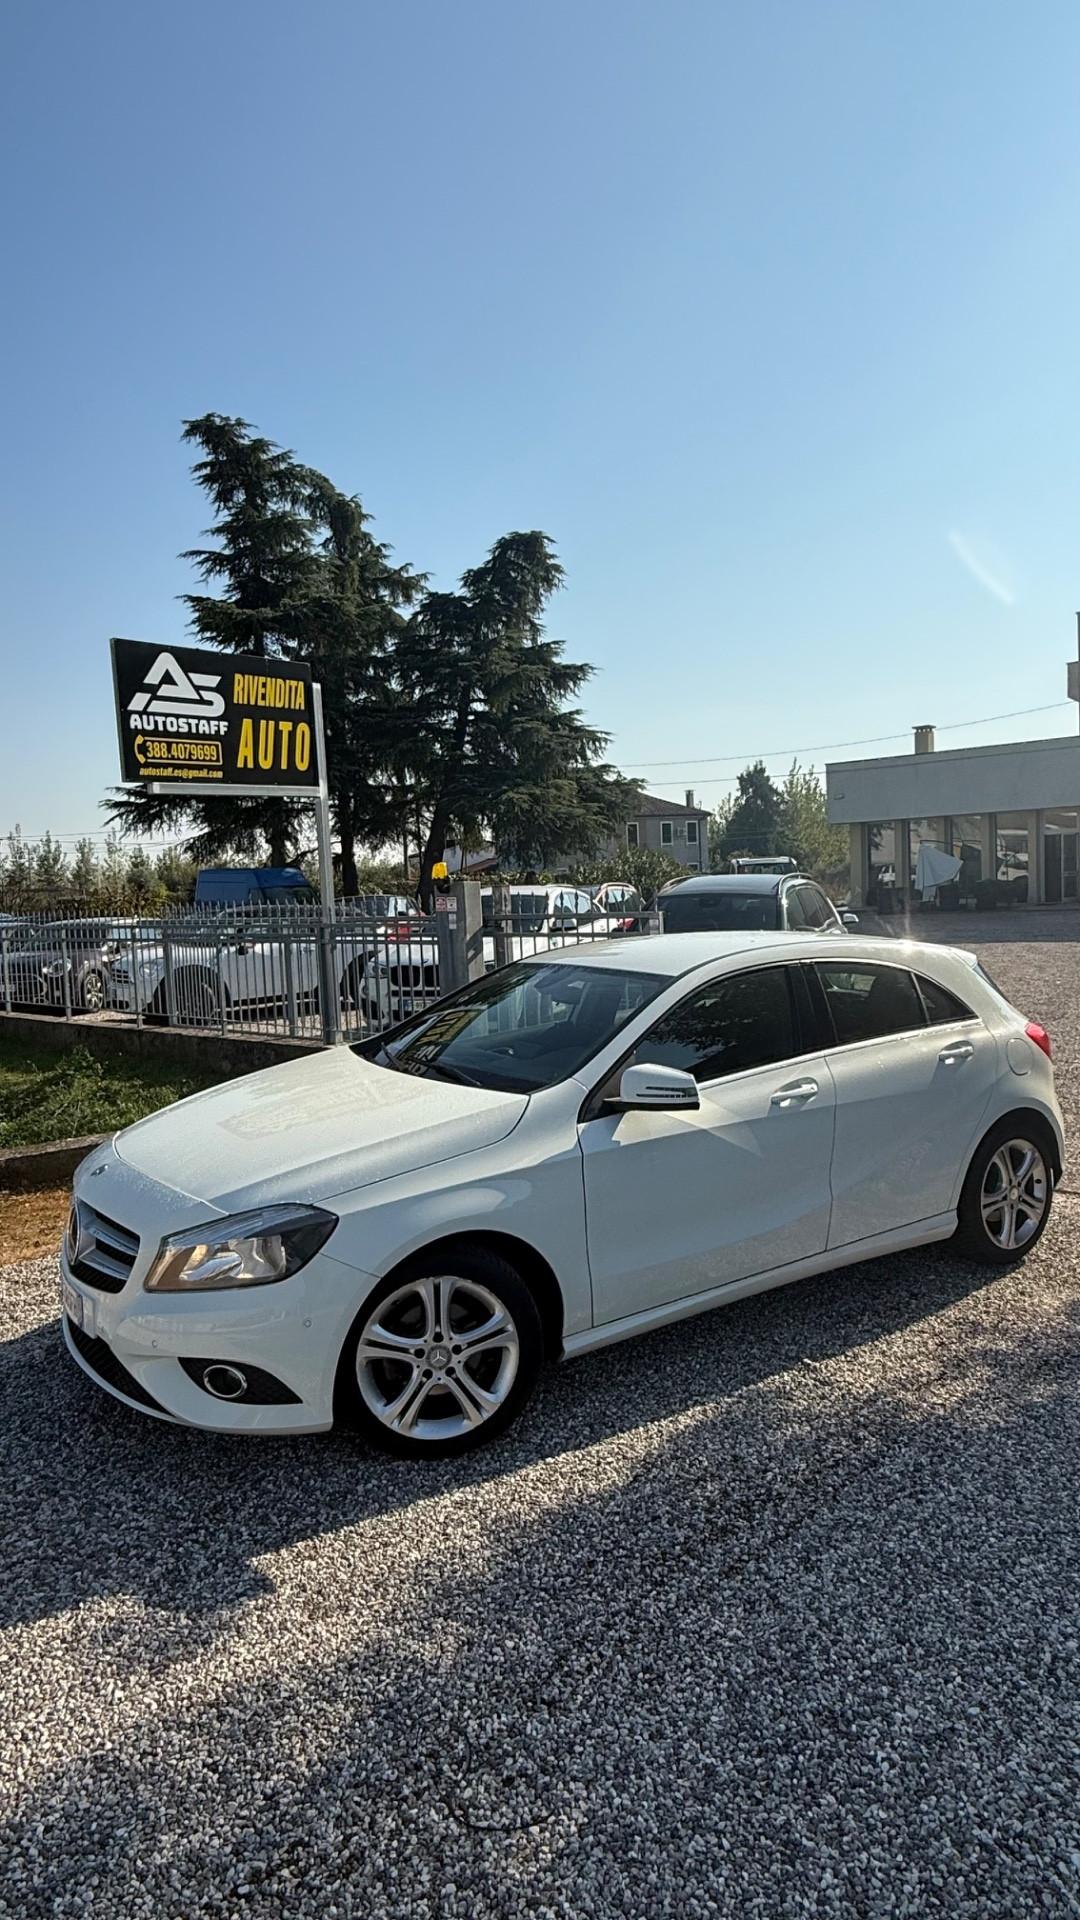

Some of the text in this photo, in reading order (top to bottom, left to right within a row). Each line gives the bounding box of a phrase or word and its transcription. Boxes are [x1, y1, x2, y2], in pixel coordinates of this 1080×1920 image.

[233, 673, 305, 710] RIVENDITA
[129, 714, 229, 735] AUTOSTAFF
[145, 741, 217, 761] 388.4079699
[237, 718, 310, 771] AUTO
